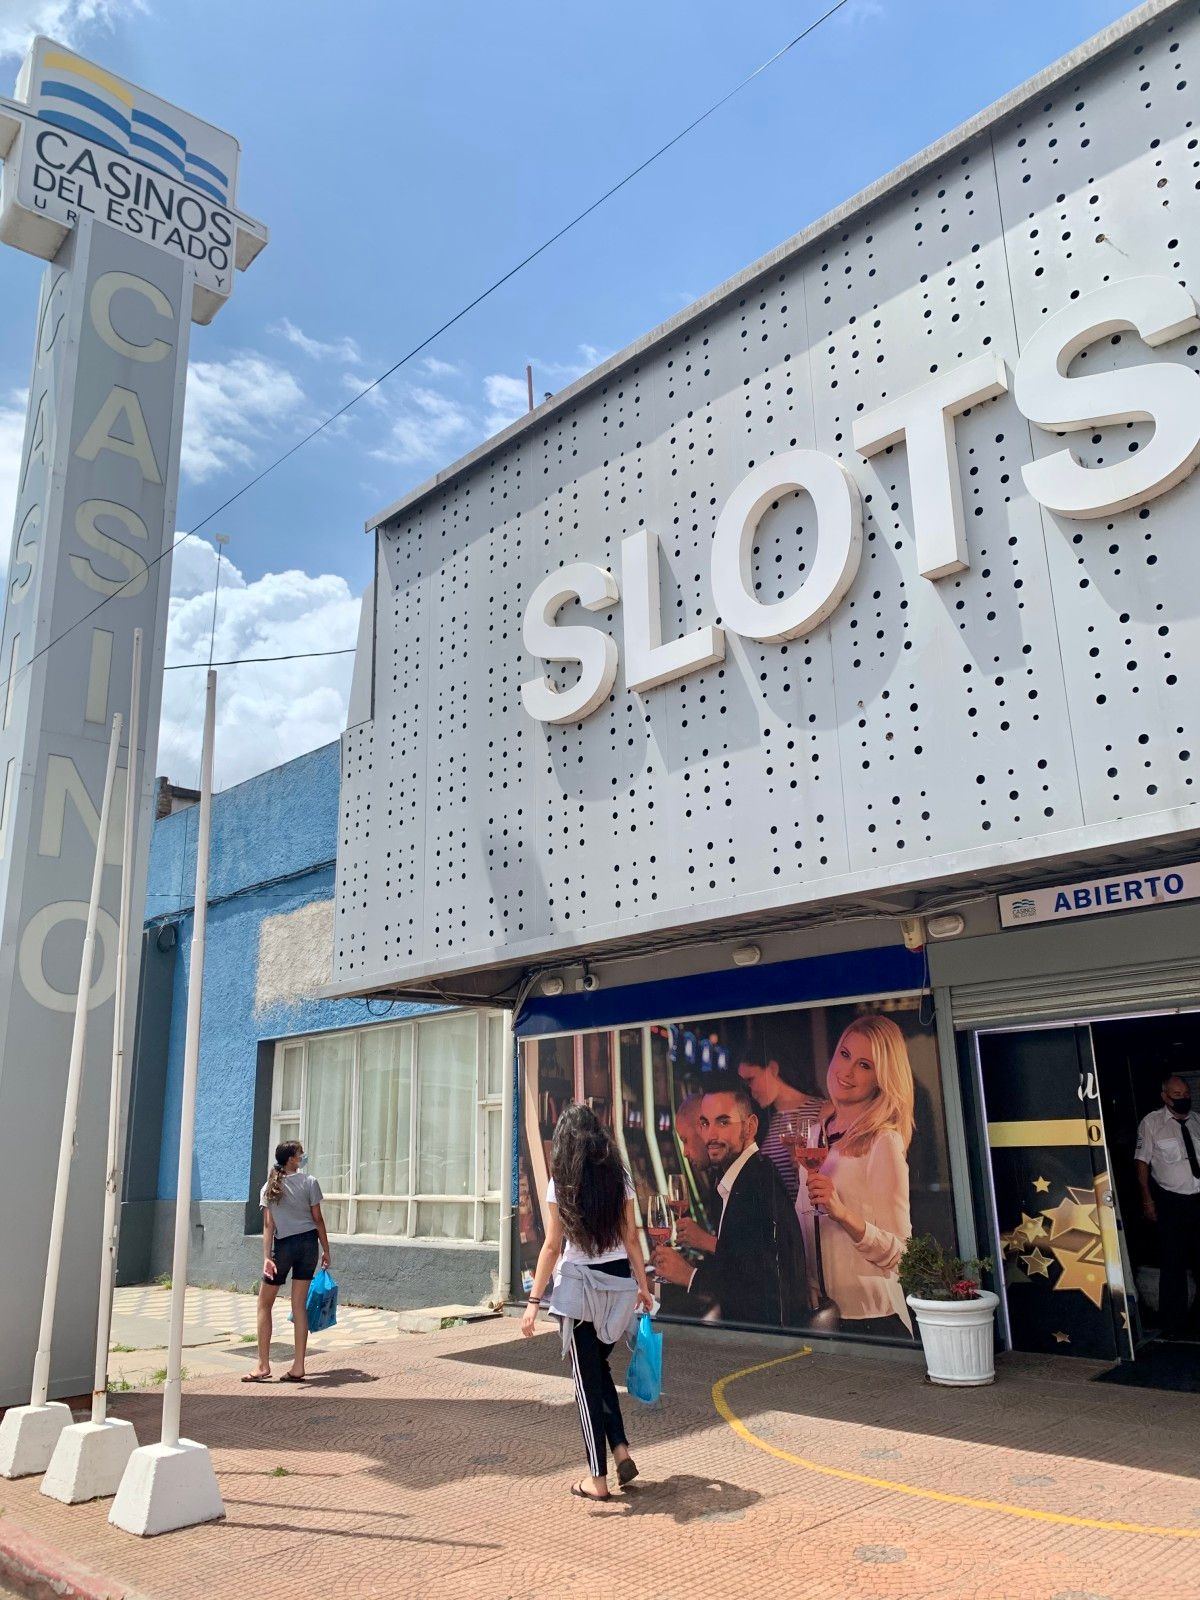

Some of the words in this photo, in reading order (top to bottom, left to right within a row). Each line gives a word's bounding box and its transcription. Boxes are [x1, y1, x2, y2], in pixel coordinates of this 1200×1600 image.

[33, 164, 96, 214] DEL
[106, 198, 229, 271] ESTADO
[35, 130, 232, 248] CASINOS
[520, 274, 1200, 726] SLOTS
[19, 269, 175, 1014] CASINO
[1053, 873, 1185, 913] ABIERTO
